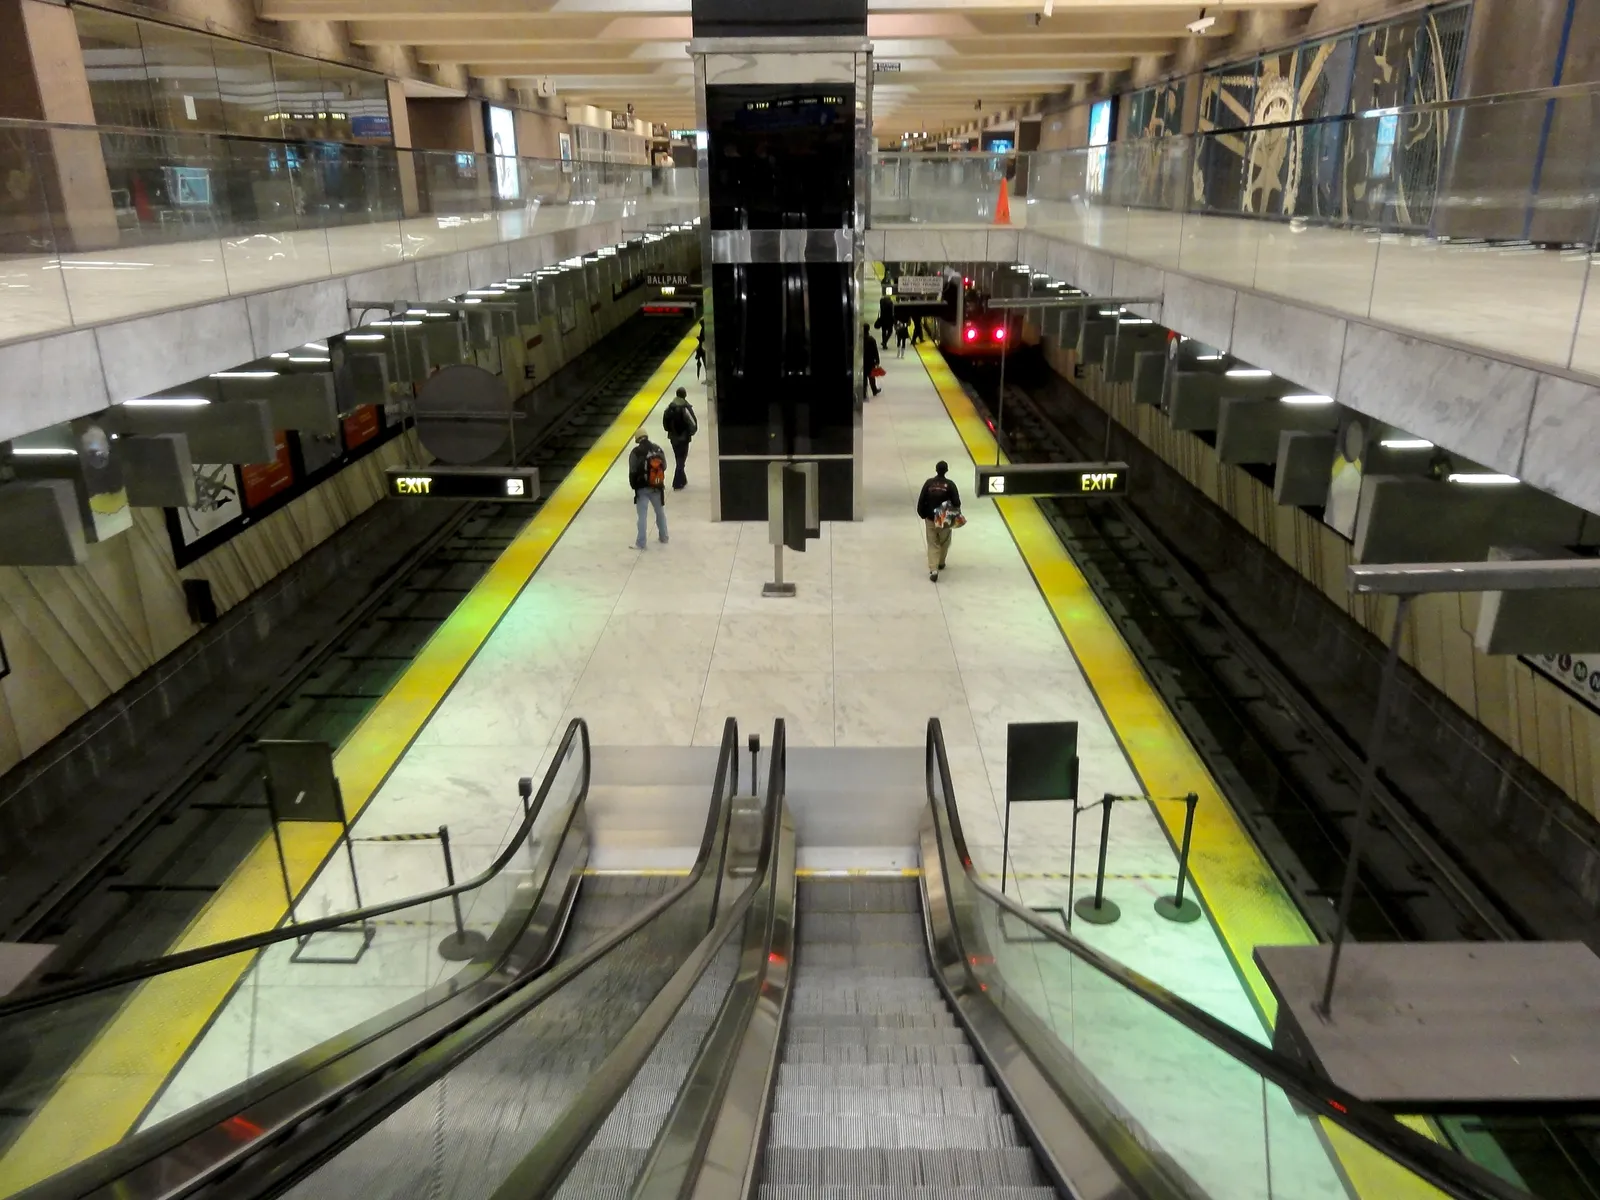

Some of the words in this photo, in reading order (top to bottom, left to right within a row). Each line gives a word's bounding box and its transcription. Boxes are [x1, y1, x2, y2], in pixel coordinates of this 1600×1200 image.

[647, 275, 688, 285] BALLPARK
[397, 477, 432, 493] EXIT
[1082, 473, 1117, 491] EXIT
